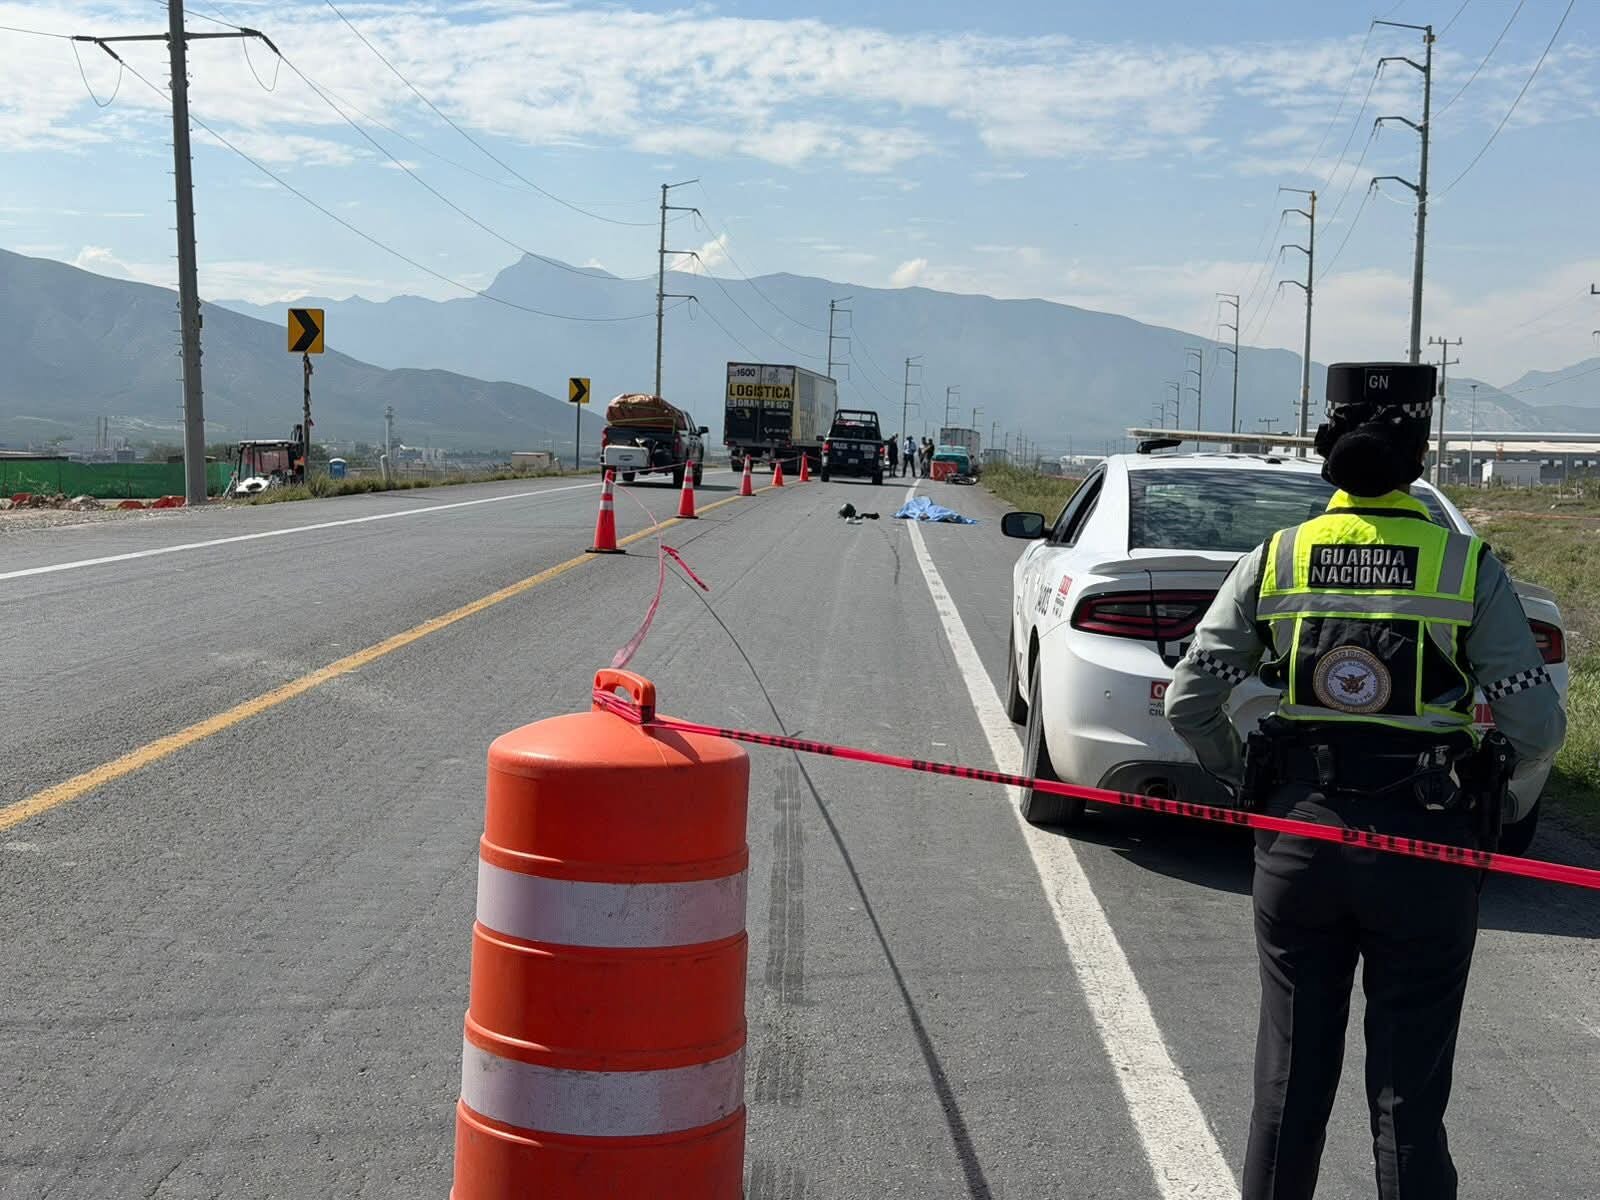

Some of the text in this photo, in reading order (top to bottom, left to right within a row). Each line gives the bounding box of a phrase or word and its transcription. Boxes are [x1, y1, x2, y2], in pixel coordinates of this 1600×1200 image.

[1368, 375, 1389, 390] GN
[729, 384, 791, 399] LOGISTICA
[1320, 548, 1405, 566] GUARDIA
[1311, 566, 1413, 584] NACIONAL
